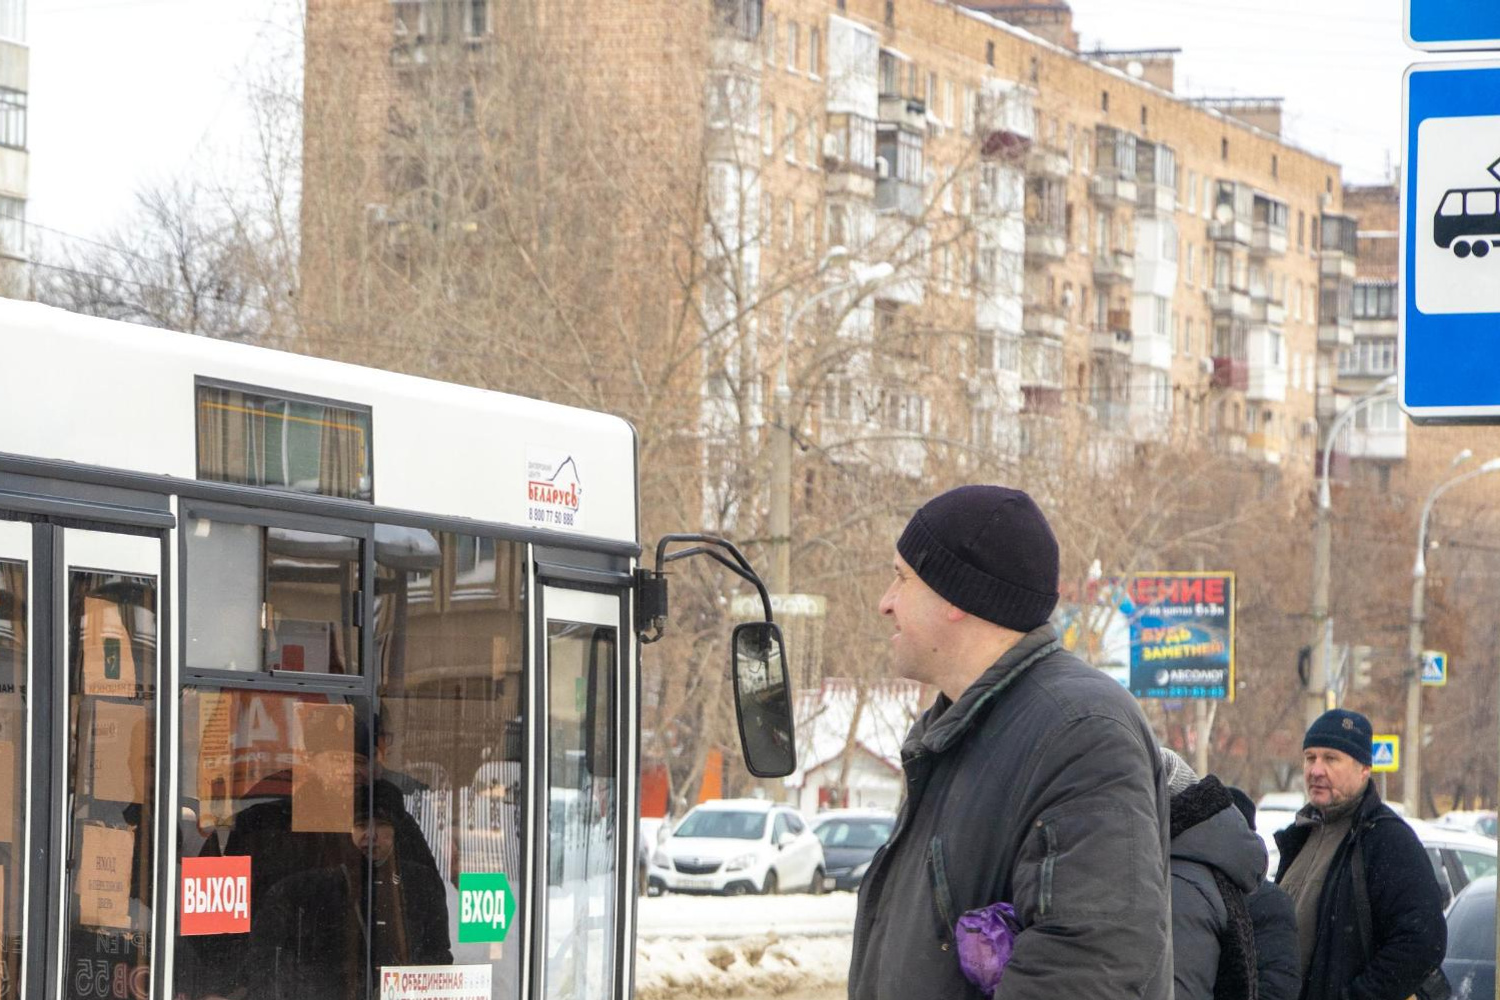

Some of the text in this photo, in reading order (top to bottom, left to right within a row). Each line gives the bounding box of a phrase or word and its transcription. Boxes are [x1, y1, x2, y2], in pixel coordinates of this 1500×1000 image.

[183, 876, 248, 919] ВЫХОД
[461, 889, 506, 929] ВХОД
[401, 973, 463, 993] ОБЪЕДИНЕННАЯ
